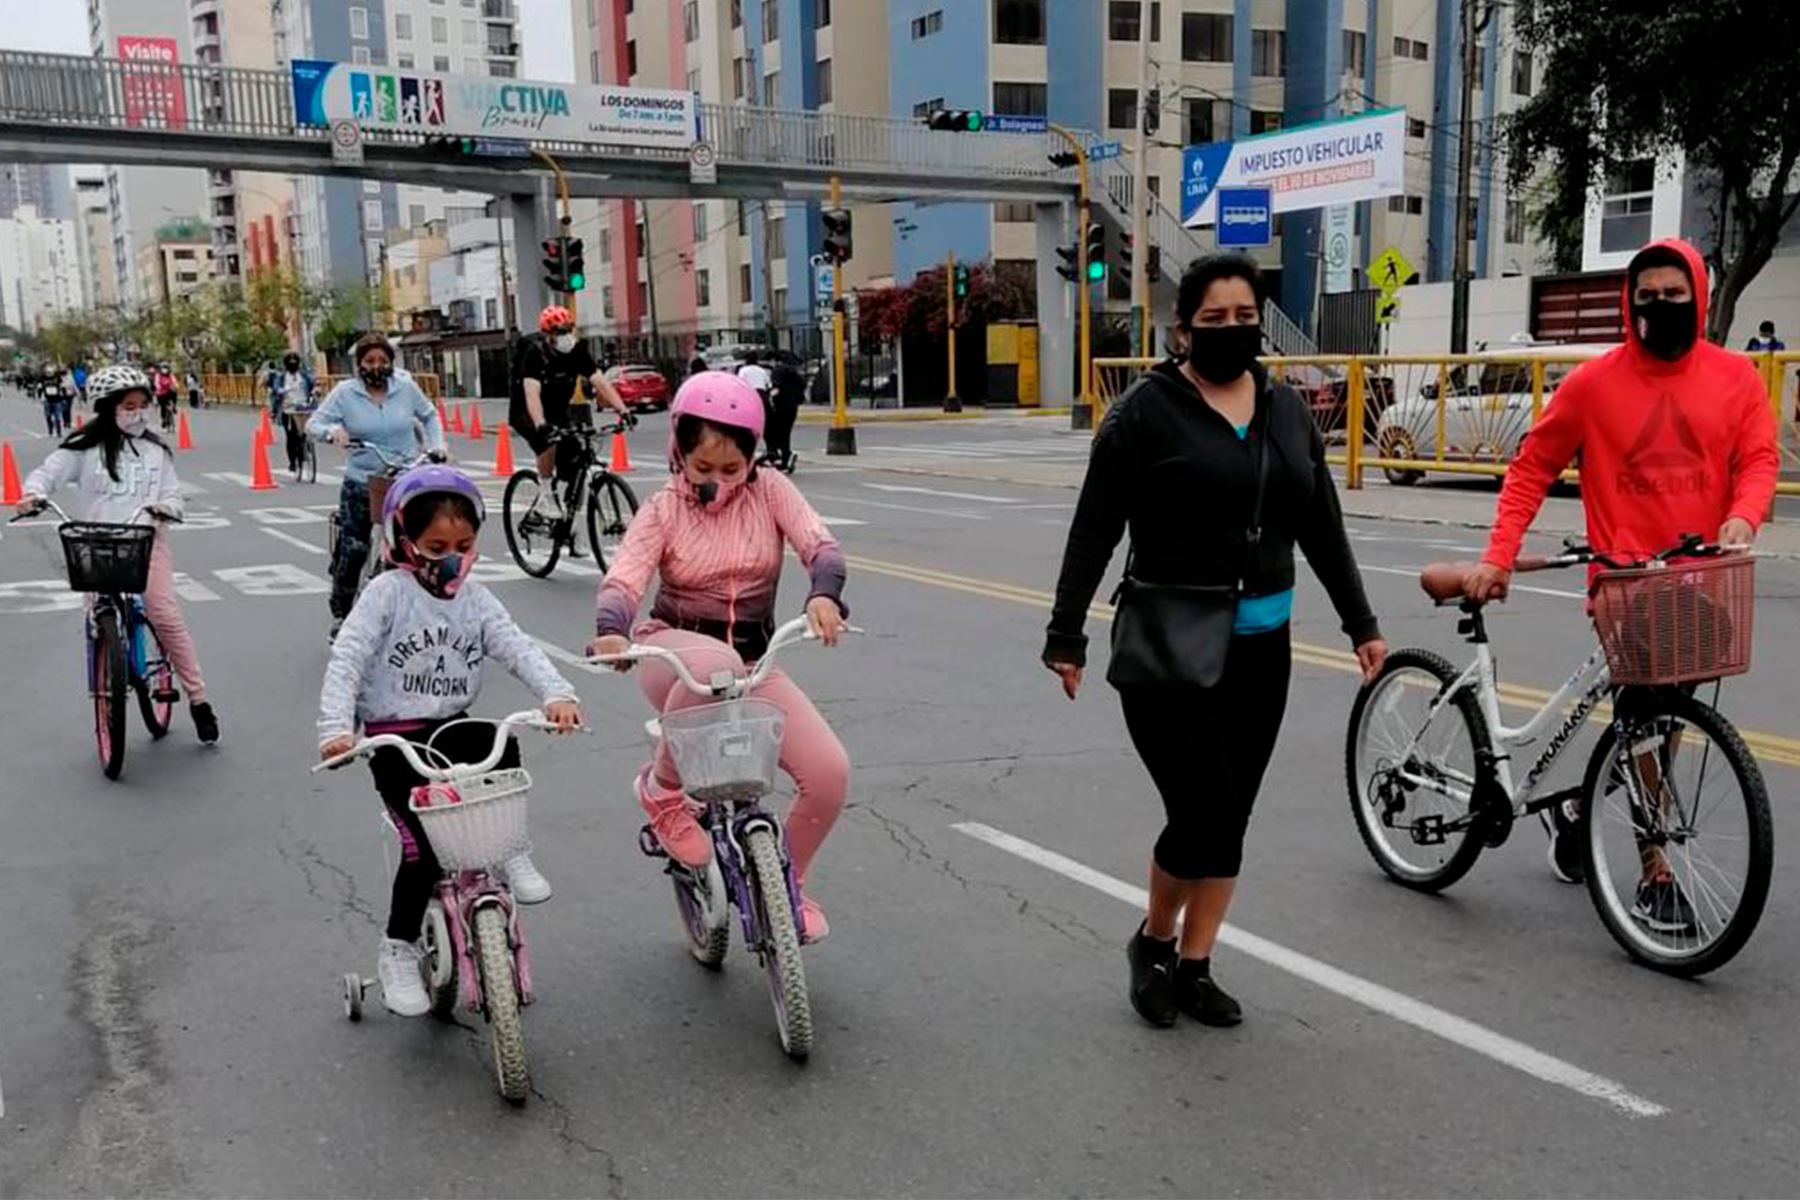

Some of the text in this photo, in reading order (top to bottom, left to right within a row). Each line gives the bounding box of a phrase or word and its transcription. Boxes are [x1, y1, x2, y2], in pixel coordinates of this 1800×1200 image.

[123, 42, 174, 60] Visite
[601, 95, 685, 110] LOS DOMINGOS
[1240, 132, 1383, 174] IMPUESTO VEHICULAR
[1186, 181, 1208, 196] LIMA
[388, 627, 448, 669] DREAM
[434, 654, 445, 673] A
[403, 673, 468, 697] UNICORN
